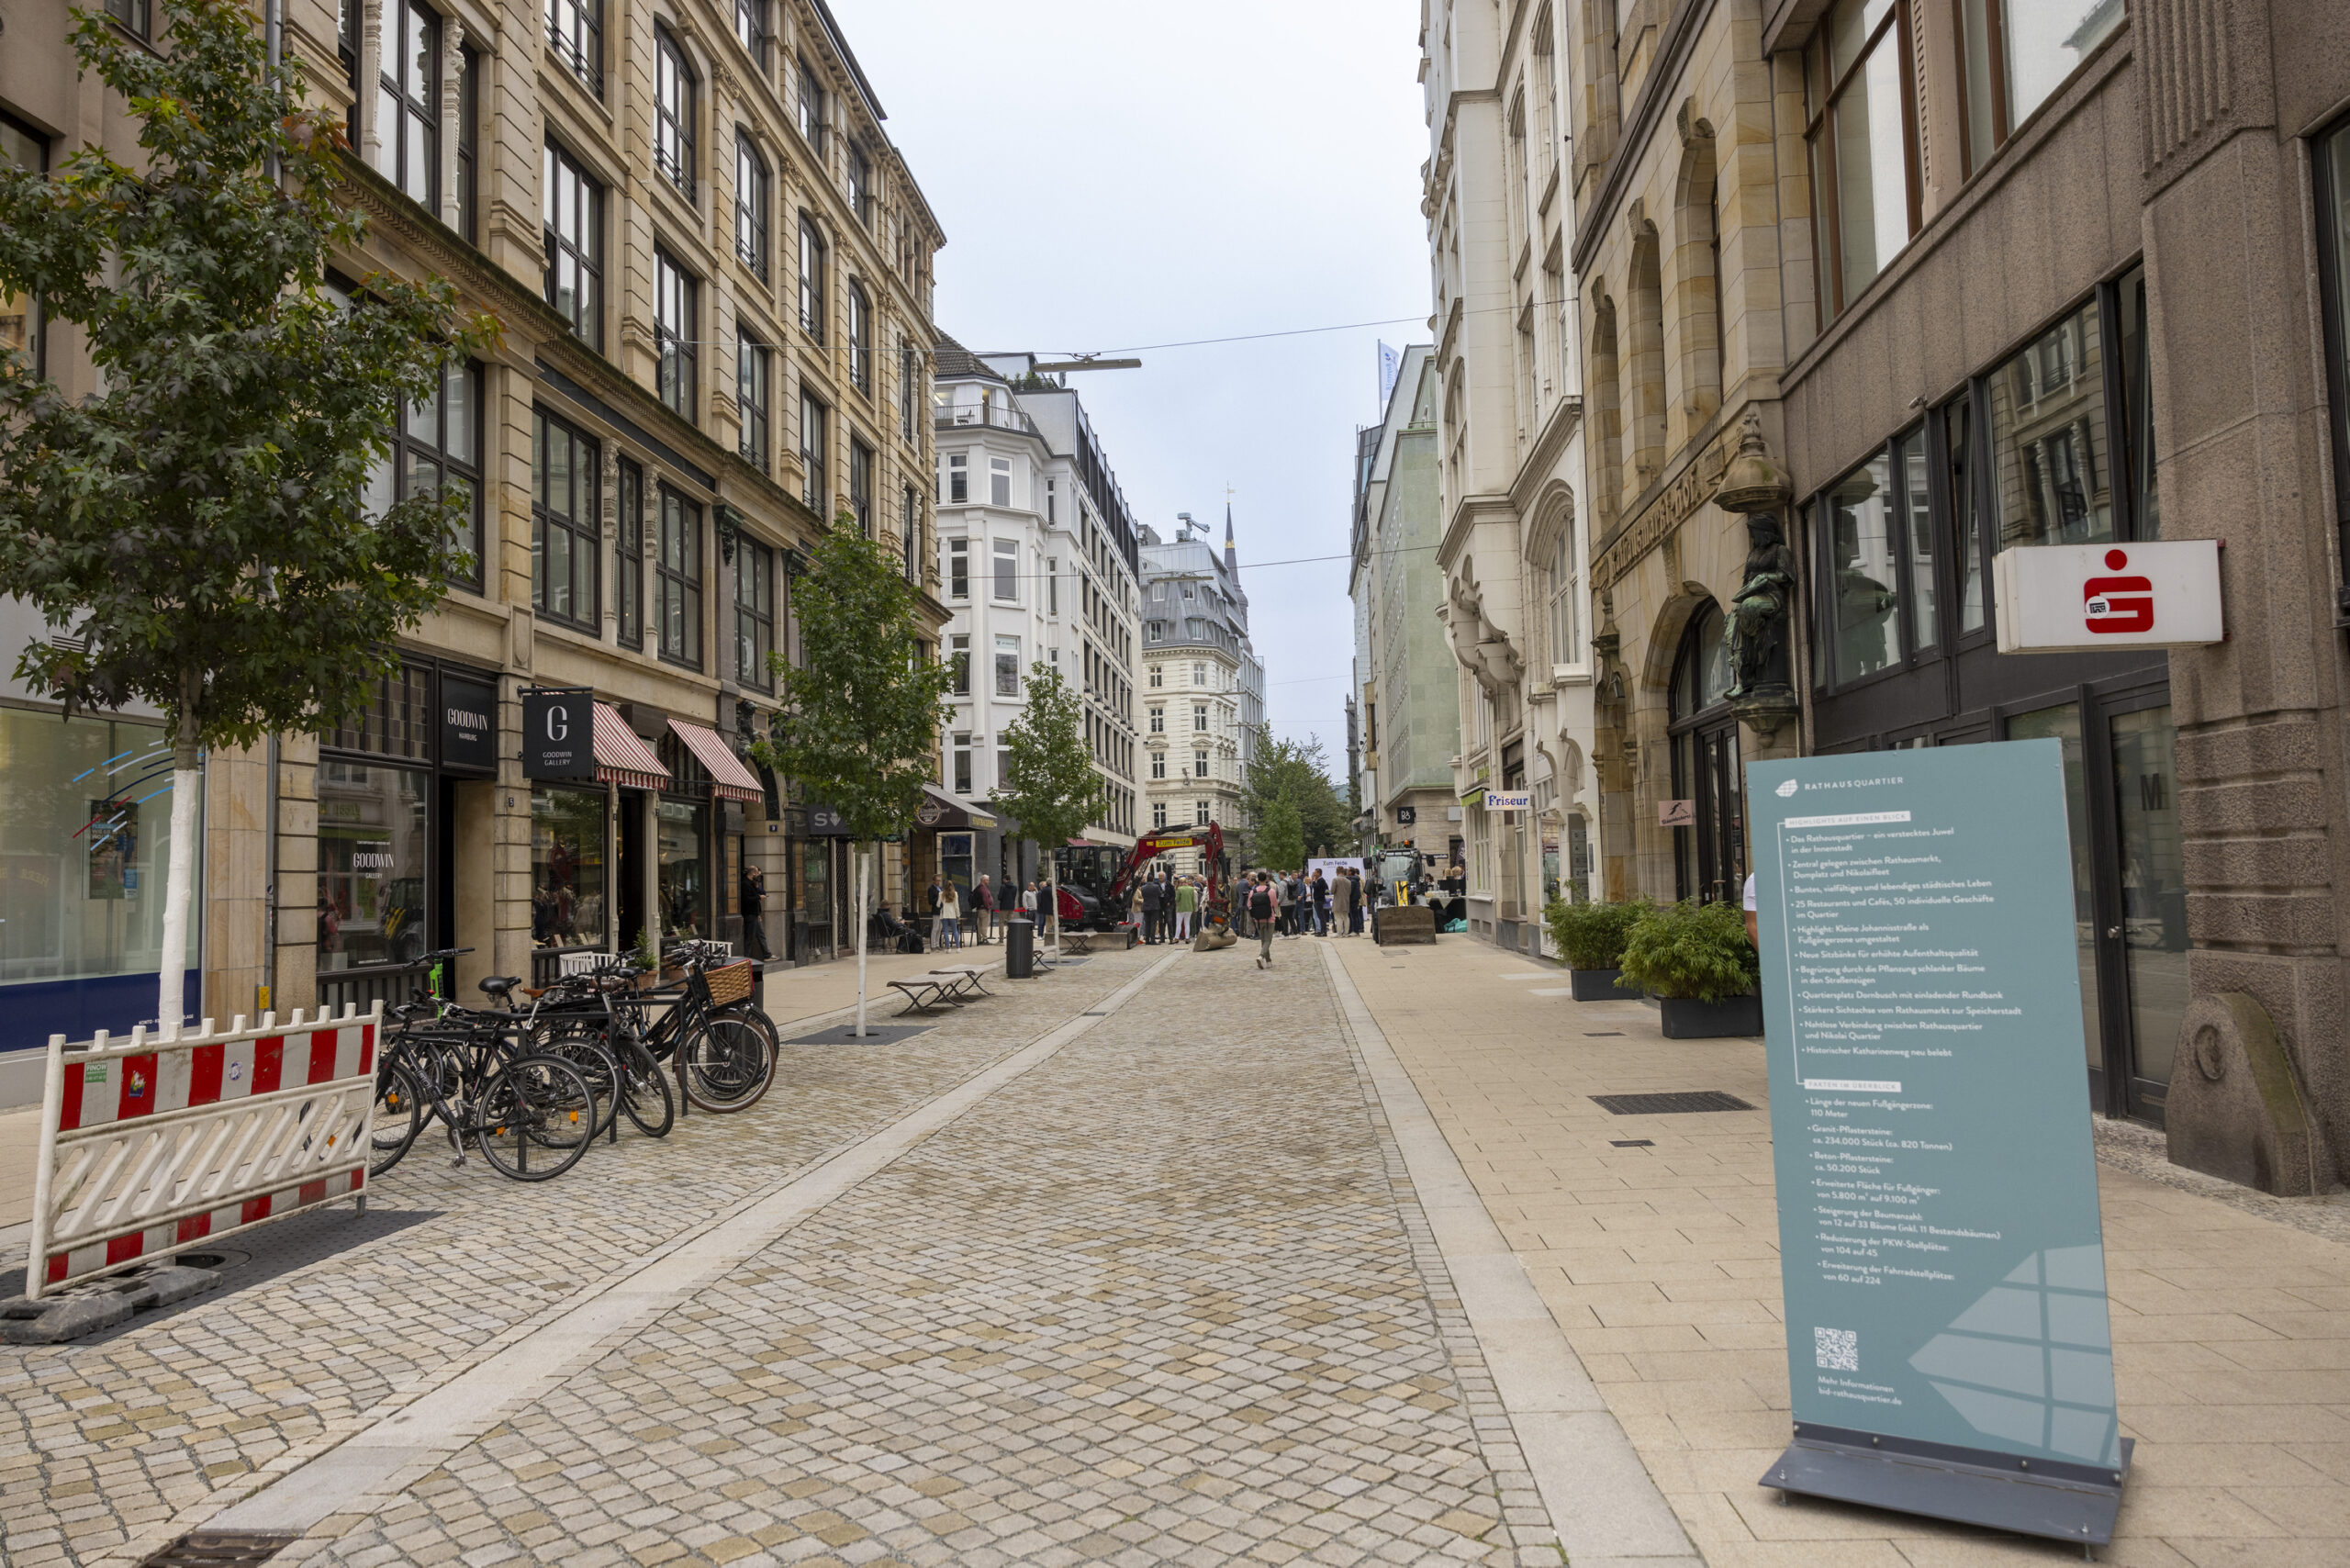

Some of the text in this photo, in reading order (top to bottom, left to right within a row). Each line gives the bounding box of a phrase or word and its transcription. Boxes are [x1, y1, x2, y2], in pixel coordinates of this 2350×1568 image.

[448, 708, 488, 731] GOODWIN
[547, 706, 567, 741] G
[1488, 795, 1528, 805] Friseur
[1807, 833, 1865, 842] Rathausquartier
[1932, 827, 1954, 836] Juwel
[353, 852, 394, 868] GOODWIN
[1820, 860, 1848, 869] gelegen
[1794, 870, 1828, 880] Domplatz
[1824, 885, 1863, 894] vielfältiges
[1880, 883, 1921, 892] lebendiges
[1923, 880, 1966, 889] städtisches
[1807, 911, 1839, 919] Quartier
[1861, 923, 1917, 932] Johannisstraße
[1799, 935, 1900, 946] Fußgängerzone umgestaltet
[1903, 949, 1979, 959] Aufenthaltsqualität
[1801, 966, 1841, 976] Begrünung
[1879, 965, 1917, 975] Pflanzung
[1825, 976, 1876, 986] Straßenzügen
[1803, 991, 1854, 1000] Quartiersplatz
[1966, 1007, 2022, 1017] Speicherstadt
[1839, 1021, 1883, 1032] Verbindung
[1920, 1022, 1983, 1032] Rathausquartier
[1849, 1032, 1881, 1040] Quartier
[1853, 1047, 1910, 1058] Katharinenweg
[1811, 1098, 1832, 1108] Länge
[1825, 1137, 1860, 1145] 234.000
[1920, 1141, 1953, 1151] Tonnen)
[1859, 1166, 1880, 1174] Stück
[1816, 1179, 1855, 1188] Erweiterte
[1857, 1181, 1882, 1190] Fläche
[1818, 1206, 1859, 1218] Steigerung
[1870, 1221, 1897, 1230] Bäume
[1929, 1226, 2001, 1239] Bestandsbäumen)
[1821, 1233, 1867, 1247] Reduzierung
[1823, 1260, 1869, 1275] Erweiterung
[1865, 1276, 1881, 1285] 224
[1818, 1376, 1894, 1393] Mehr Informationen
[1819, 1387, 1902, 1405] bid-rathausquartier.de
